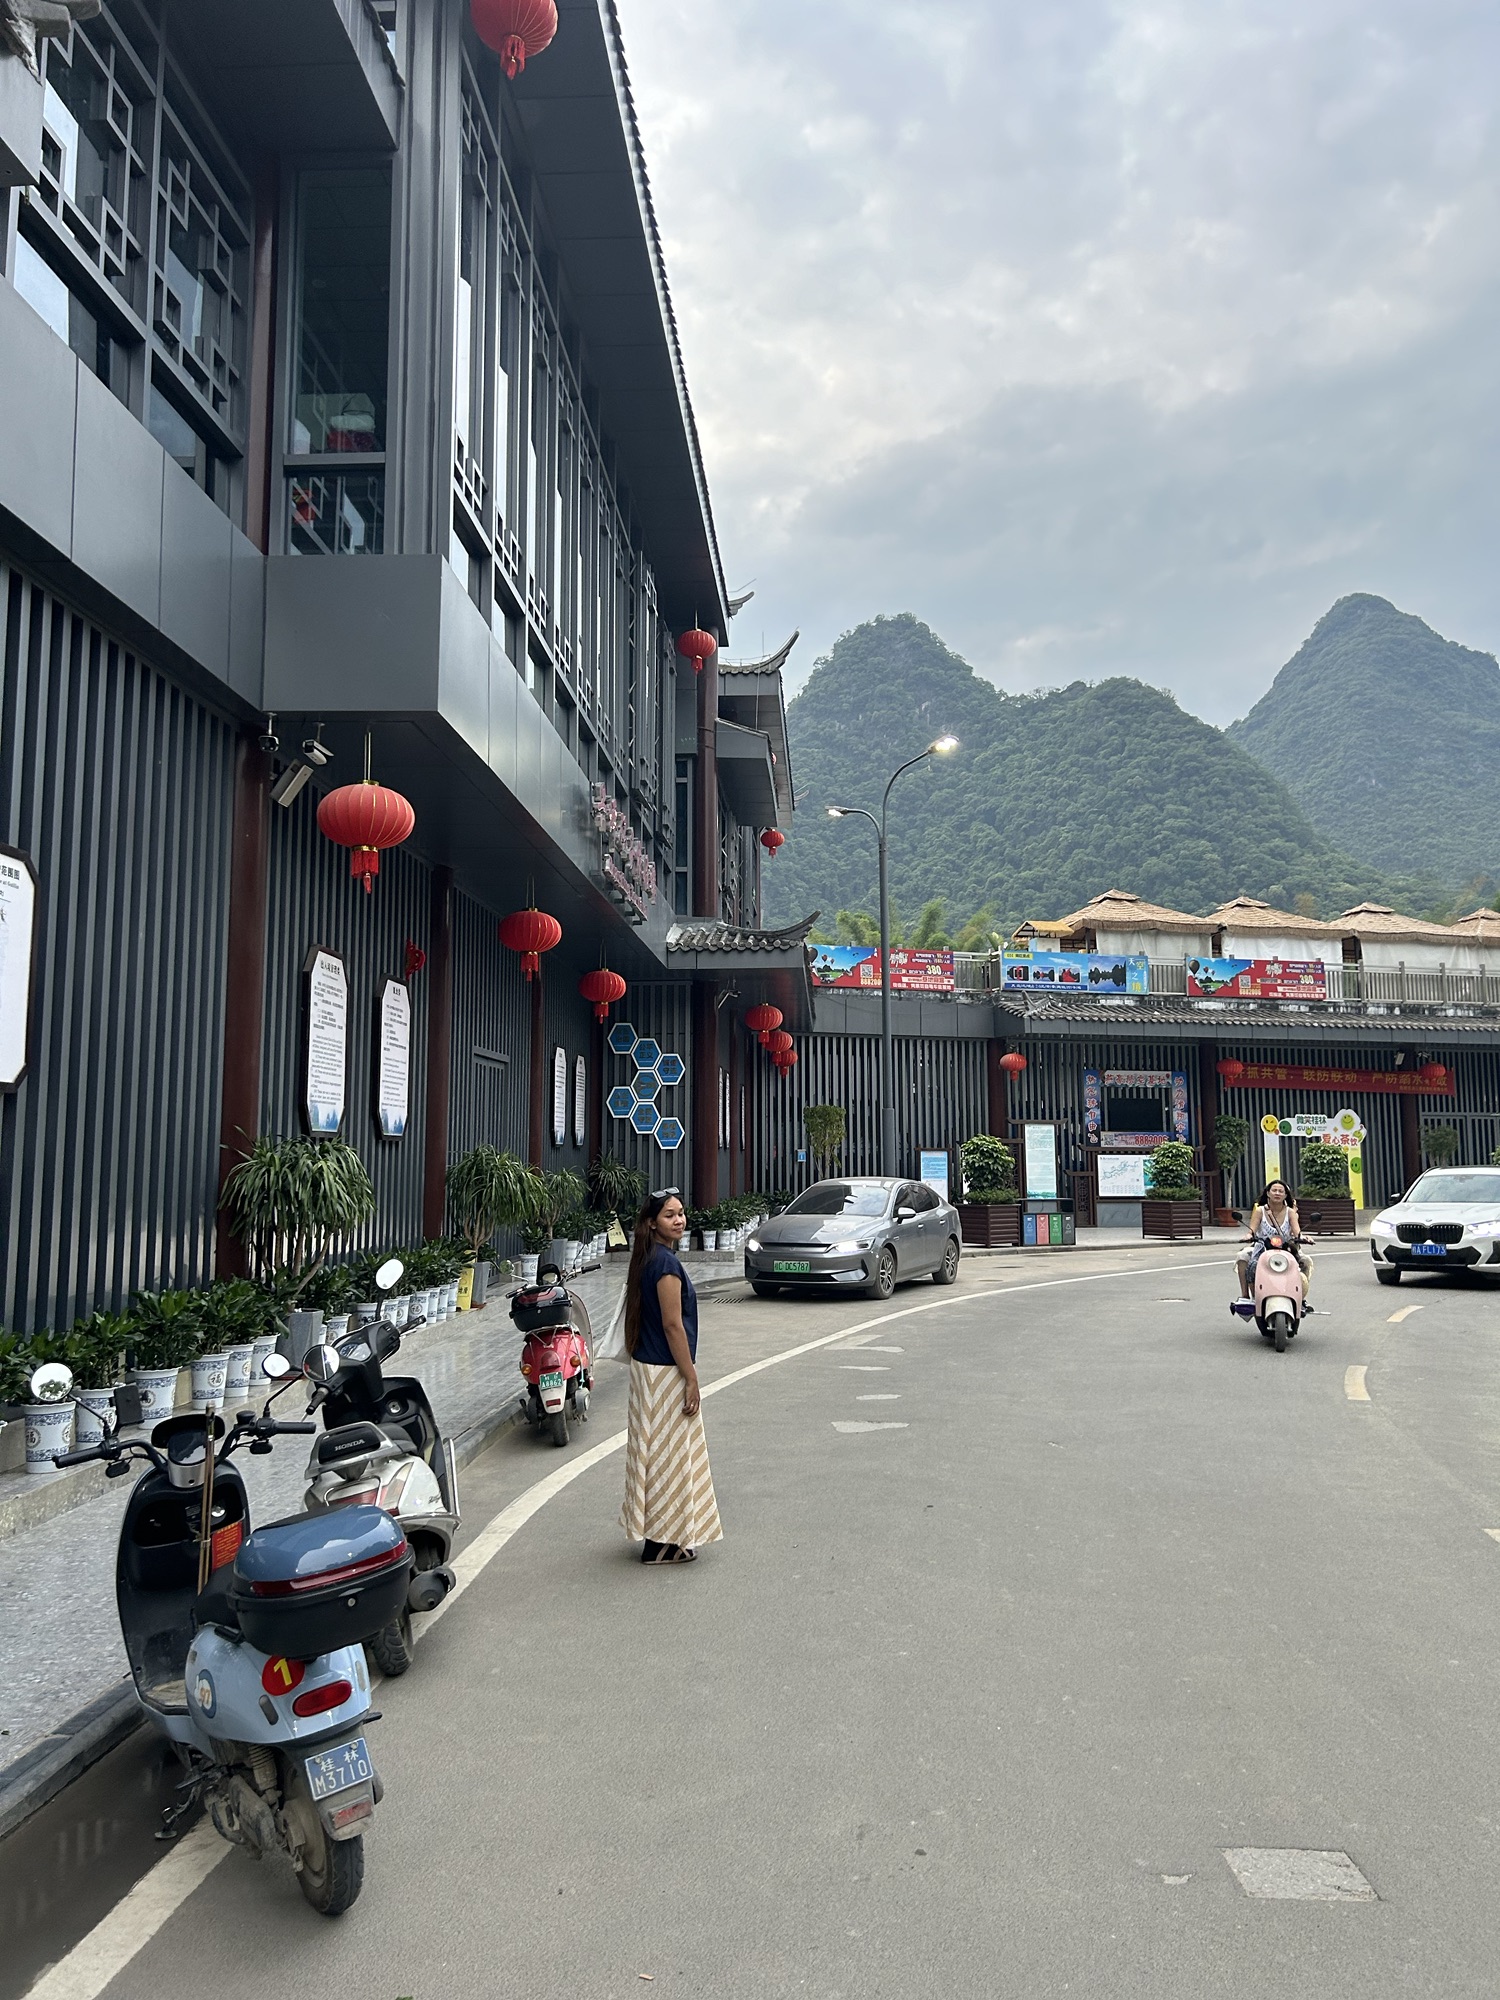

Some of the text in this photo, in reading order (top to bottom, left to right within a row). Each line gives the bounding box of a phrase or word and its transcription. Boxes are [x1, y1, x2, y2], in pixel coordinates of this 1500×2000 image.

[926, 964, 942, 975] 380
[1296, 1115, 1327, 1125] 微笑桂林
[1321, 1133, 1358, 1147] 爱心茶饮
[334, 1438, 366, 1452] HONDA
[273, 1657, 293, 1687] 1
[320, 1749, 360, 1773] 桂林
[315, 1759, 369, 1795] M3710
